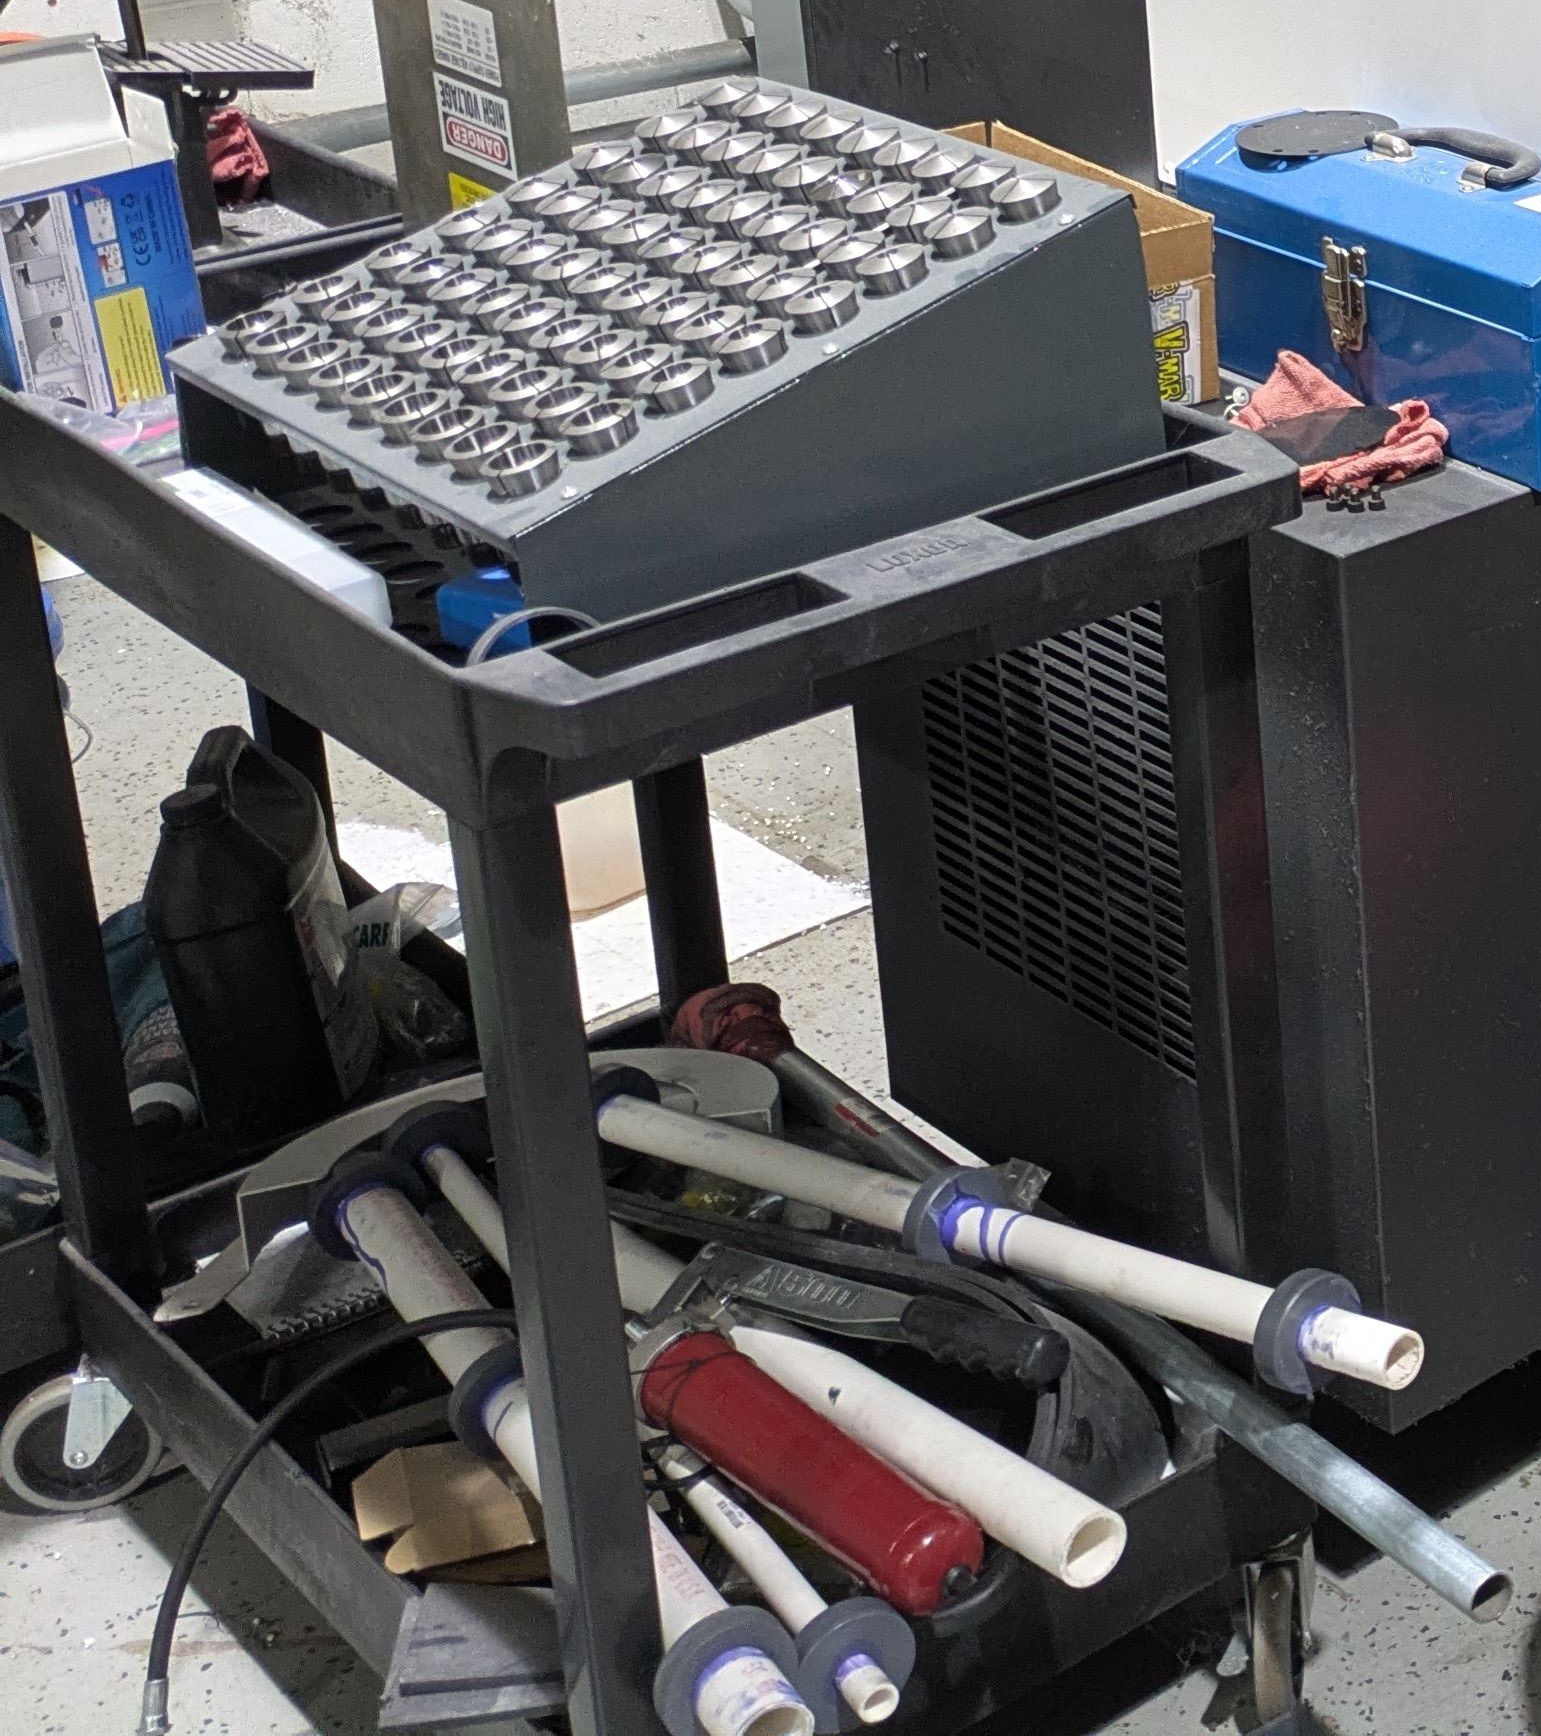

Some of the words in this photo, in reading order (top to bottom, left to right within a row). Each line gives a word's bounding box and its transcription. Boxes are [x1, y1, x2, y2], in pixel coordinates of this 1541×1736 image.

[439, 80, 481, 122] VOLTAGE
[480, 97, 506, 132] HIGH
[451, 123, 503, 160] DANGER
